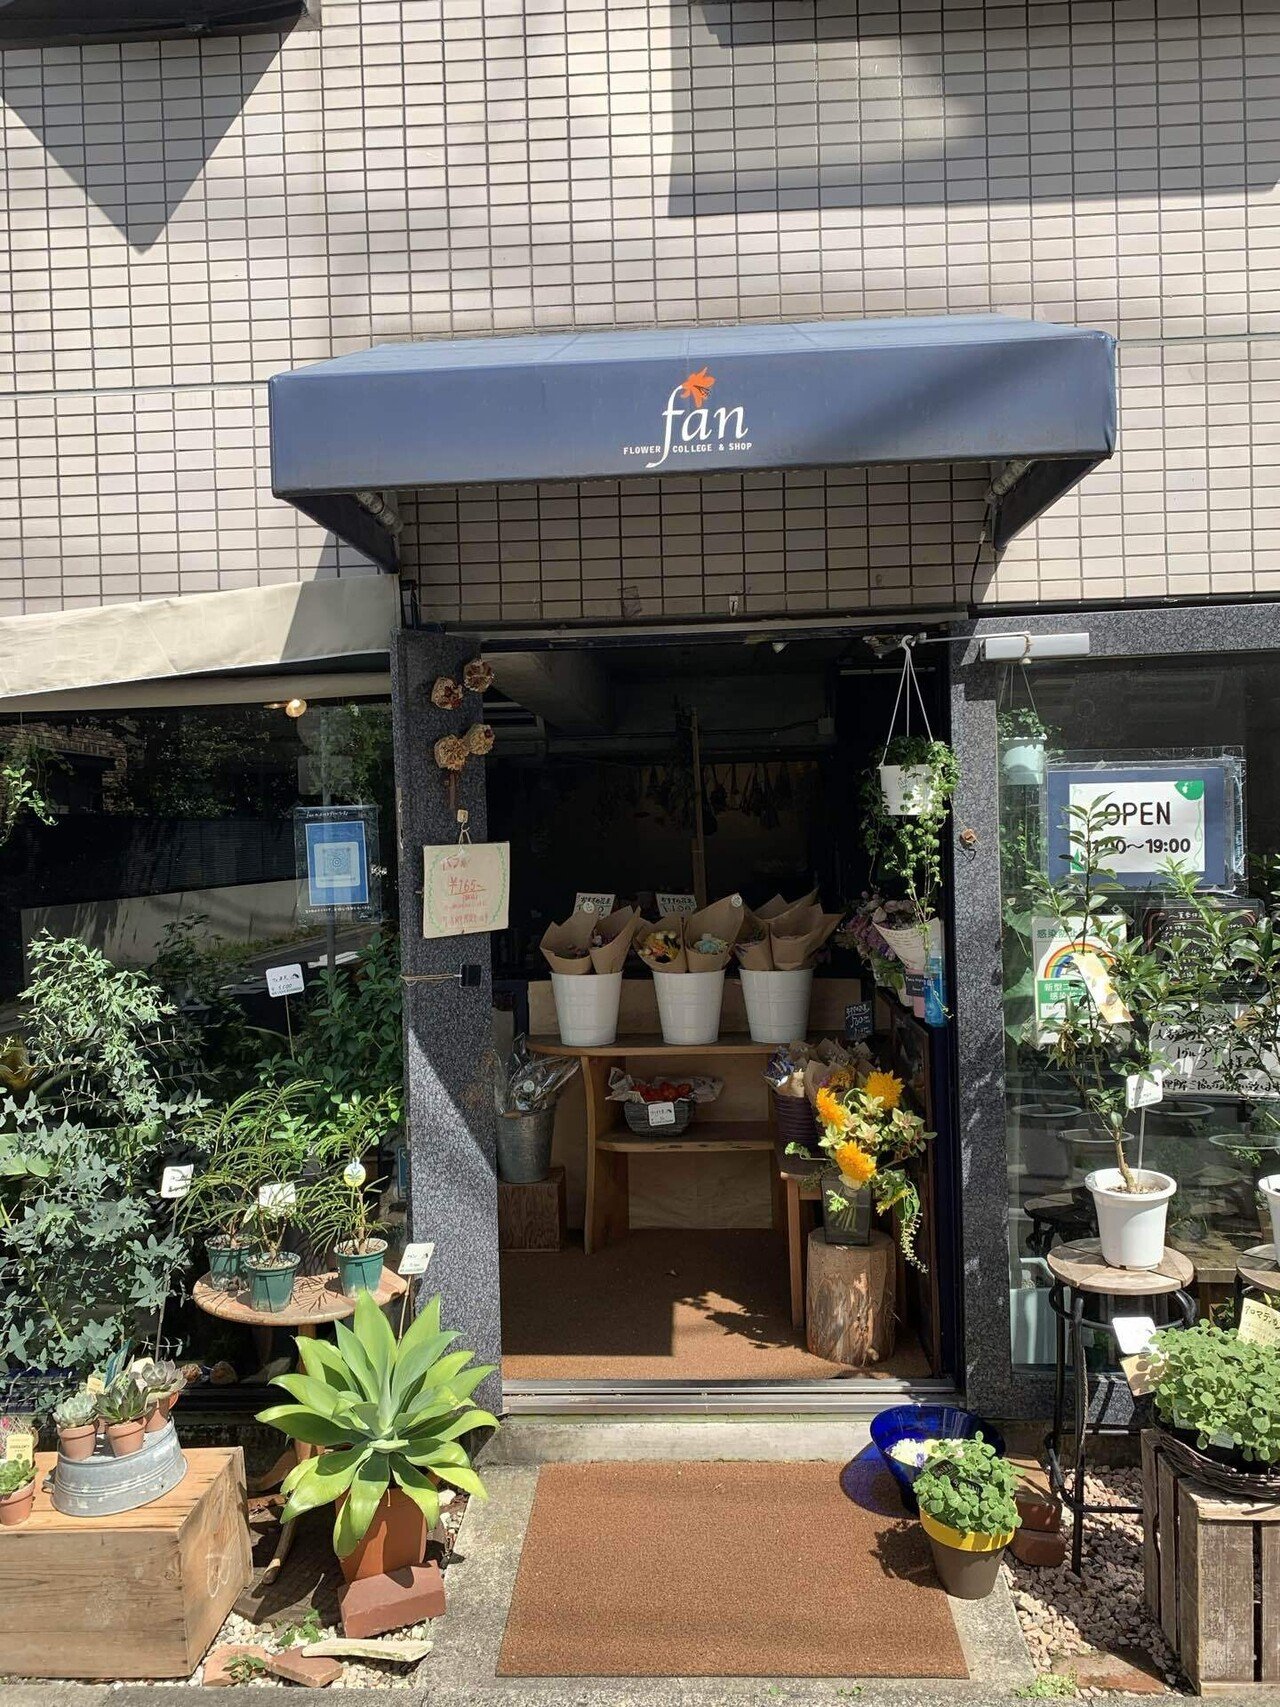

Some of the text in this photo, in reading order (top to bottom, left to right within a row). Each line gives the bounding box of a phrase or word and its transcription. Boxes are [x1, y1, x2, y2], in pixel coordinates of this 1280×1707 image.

[643, 384, 749, 469] fan
[623, 442, 753, 455] FLOWER COLLEGE & SHOP
[1104, 801, 1171, 826] OPEN
